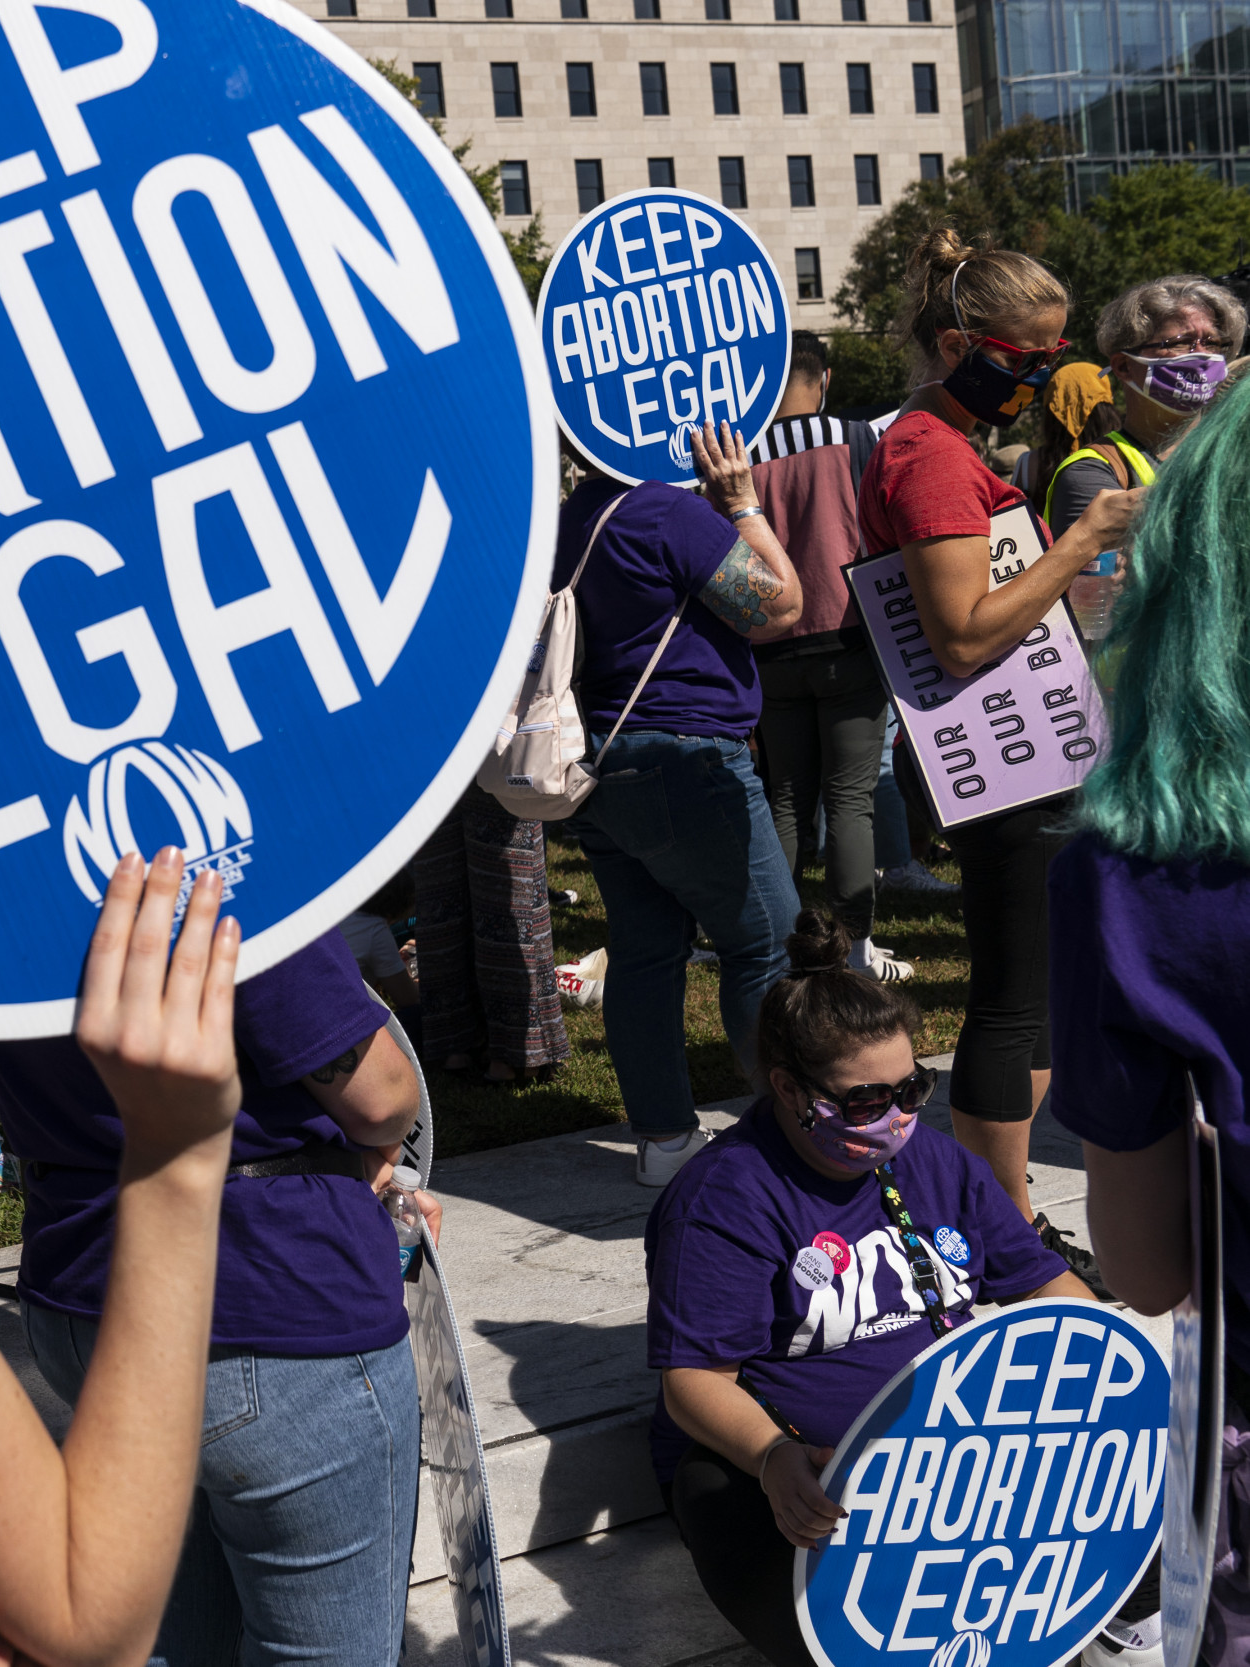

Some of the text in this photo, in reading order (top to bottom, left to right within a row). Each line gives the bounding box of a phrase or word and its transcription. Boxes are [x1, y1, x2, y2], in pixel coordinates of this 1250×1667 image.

[576, 202, 722, 293] KEEP
[553, 261, 776, 384] ABORTION
[584, 346, 766, 448] LEGAL
[1175, 381, 1200, 392] OFF
[1176, 371, 1208, 383] BANS
[874, 571, 986, 799] OUR FUTURE
[989, 537, 1097, 762] OUR BOES
[981, 688, 1036, 766] OUR
[63, 741, 254, 904] NOW
[507, 778, 531, 786] adidas
[795, 1261, 822, 1285] BODIES
[800, 1256, 829, 1284] OFF OUR
[803, 1251, 823, 1269] BANS
[936, 1227, 951, 1245] KEEP
[924, 1316, 1146, 1428] KEEP
[830, 1427, 1168, 1546] ABORTION
[842, 1539, 1109, 1652] LEGAL
